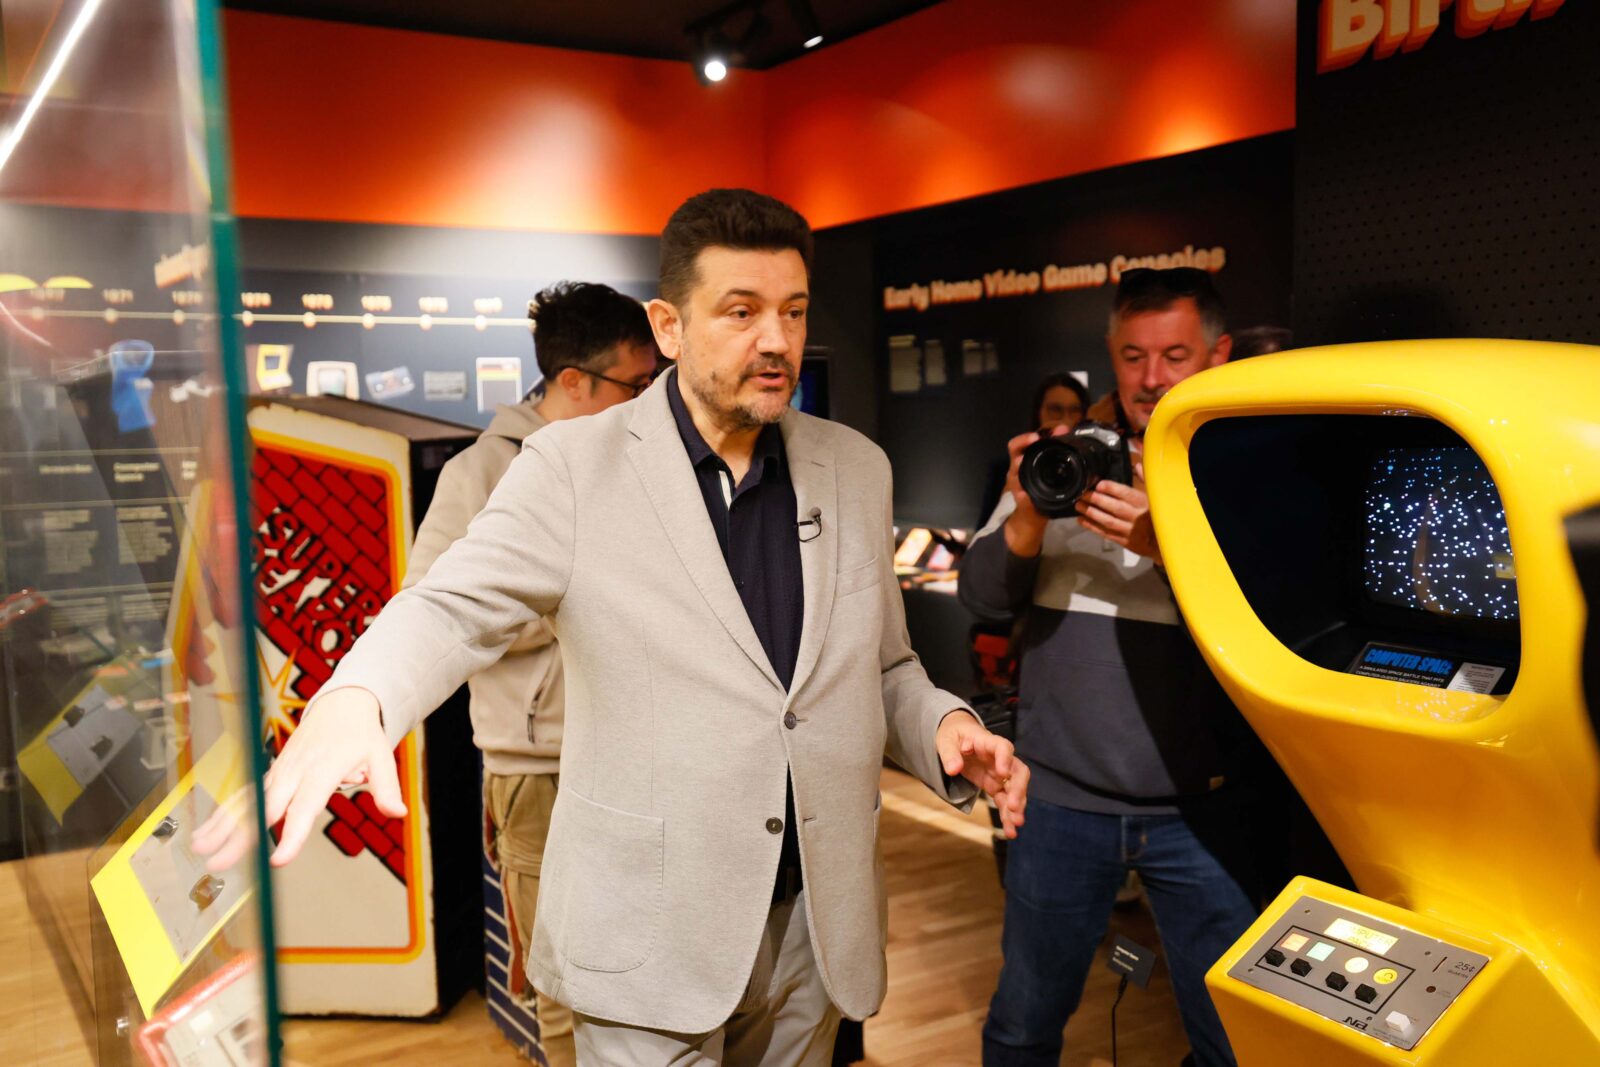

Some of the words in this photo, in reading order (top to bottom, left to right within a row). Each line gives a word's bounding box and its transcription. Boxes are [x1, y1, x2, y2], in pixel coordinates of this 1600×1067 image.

[884, 283, 929, 312] Early
[930, 278, 982, 304] Home
[983, 268, 1040, 298] Video
[1042, 262, 1108, 292] Game
[259, 509, 383, 637] SUPER
[1364, 648, 1421, 669] COMPUTER
[1418, 656, 1453, 675] SPACE
[1455, 961, 1476, 972] 25¢
